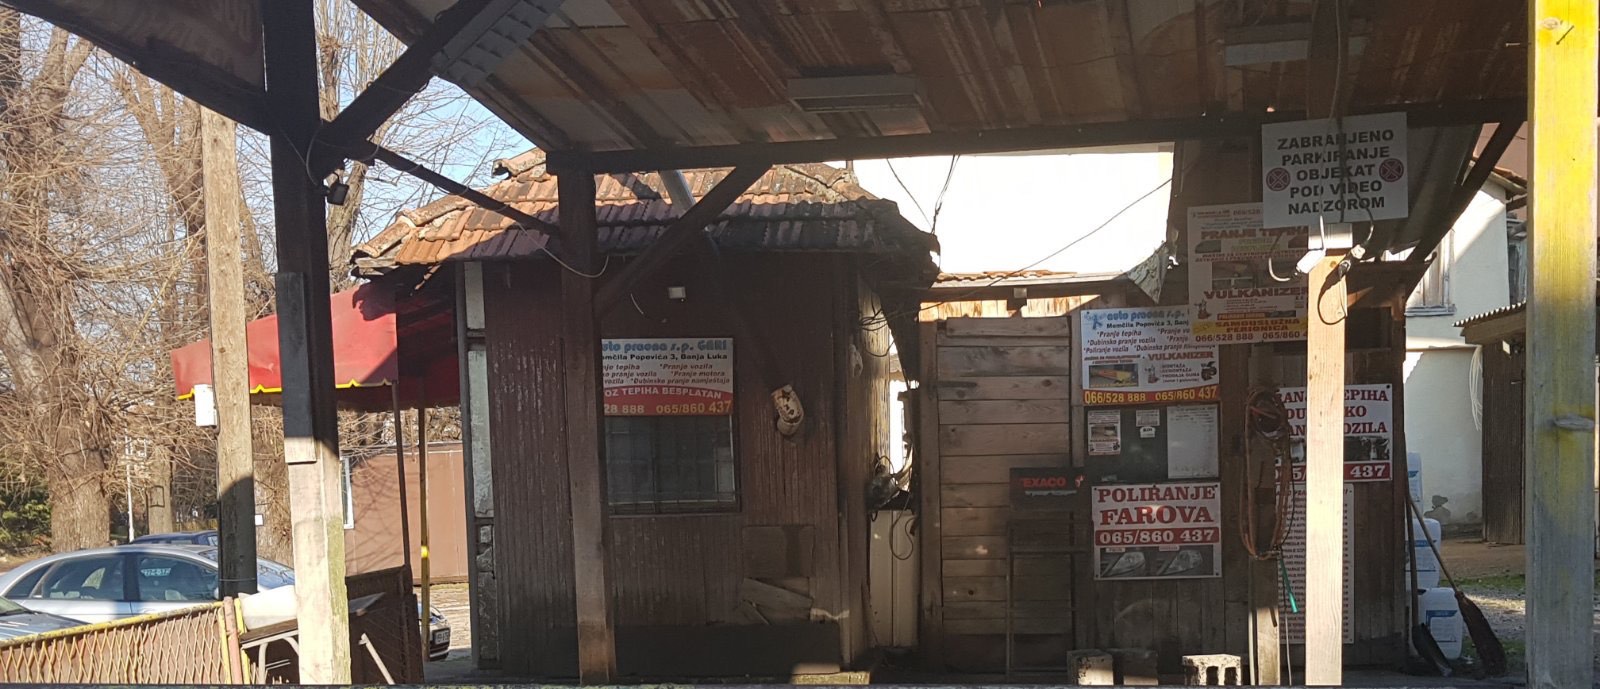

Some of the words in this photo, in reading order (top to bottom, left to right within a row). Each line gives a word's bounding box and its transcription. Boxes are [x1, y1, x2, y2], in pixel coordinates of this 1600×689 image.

[1296, 164, 1375, 181] OBJEKAT
[1290, 185, 1324, 198] POD
[1329, 180, 1382, 195] VIDEO
[1288, 197, 1385, 215] NADZOROM
[1195, 332, 1233, 342] 066/528
[1236, 332, 1253, 340] 888
[1147, 351, 1214, 361] VULKANIZER
[622, 387, 659, 396] TEPIHA
[662, 387, 722, 399] BESPLATAN
[1085, 391, 1124, 404] 066/528
[1128, 392, 1146, 402] 888
[1155, 389, 1195, 400] 065/860
[1198, 386, 1217, 399] 437
[1344, 389, 1390, 401] EPIHA
[622, 404, 645, 413] 888
[656, 403, 705, 413] 065/860
[708, 400, 732, 413] 437
[1344, 421, 1388, 434] OZILA
[1350, 464, 1386, 478] 437
[1098, 484, 1216, 502] POLIRANJE
[1100, 505, 1214, 526] FAROVA
[1100, 529, 1174, 544] 065/860
[1179, 528, 1215, 542] 437
